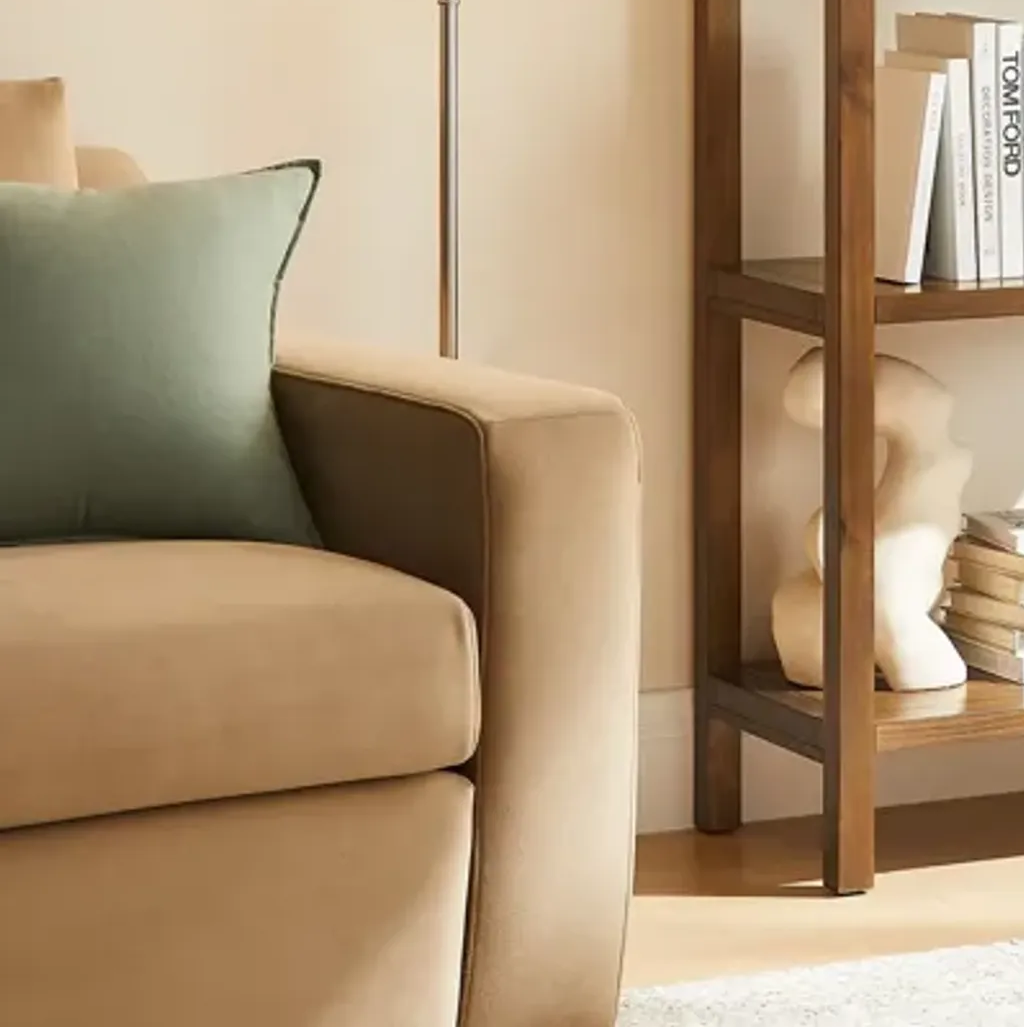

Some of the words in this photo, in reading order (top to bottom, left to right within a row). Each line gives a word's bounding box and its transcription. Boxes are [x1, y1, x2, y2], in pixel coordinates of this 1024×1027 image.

[1002, 51, 1020, 106] TOM
[981, 86, 994, 170] DECORATION
[1002, 109, 1021, 177] FORD
[982, 173, 996, 222] DESIGN
